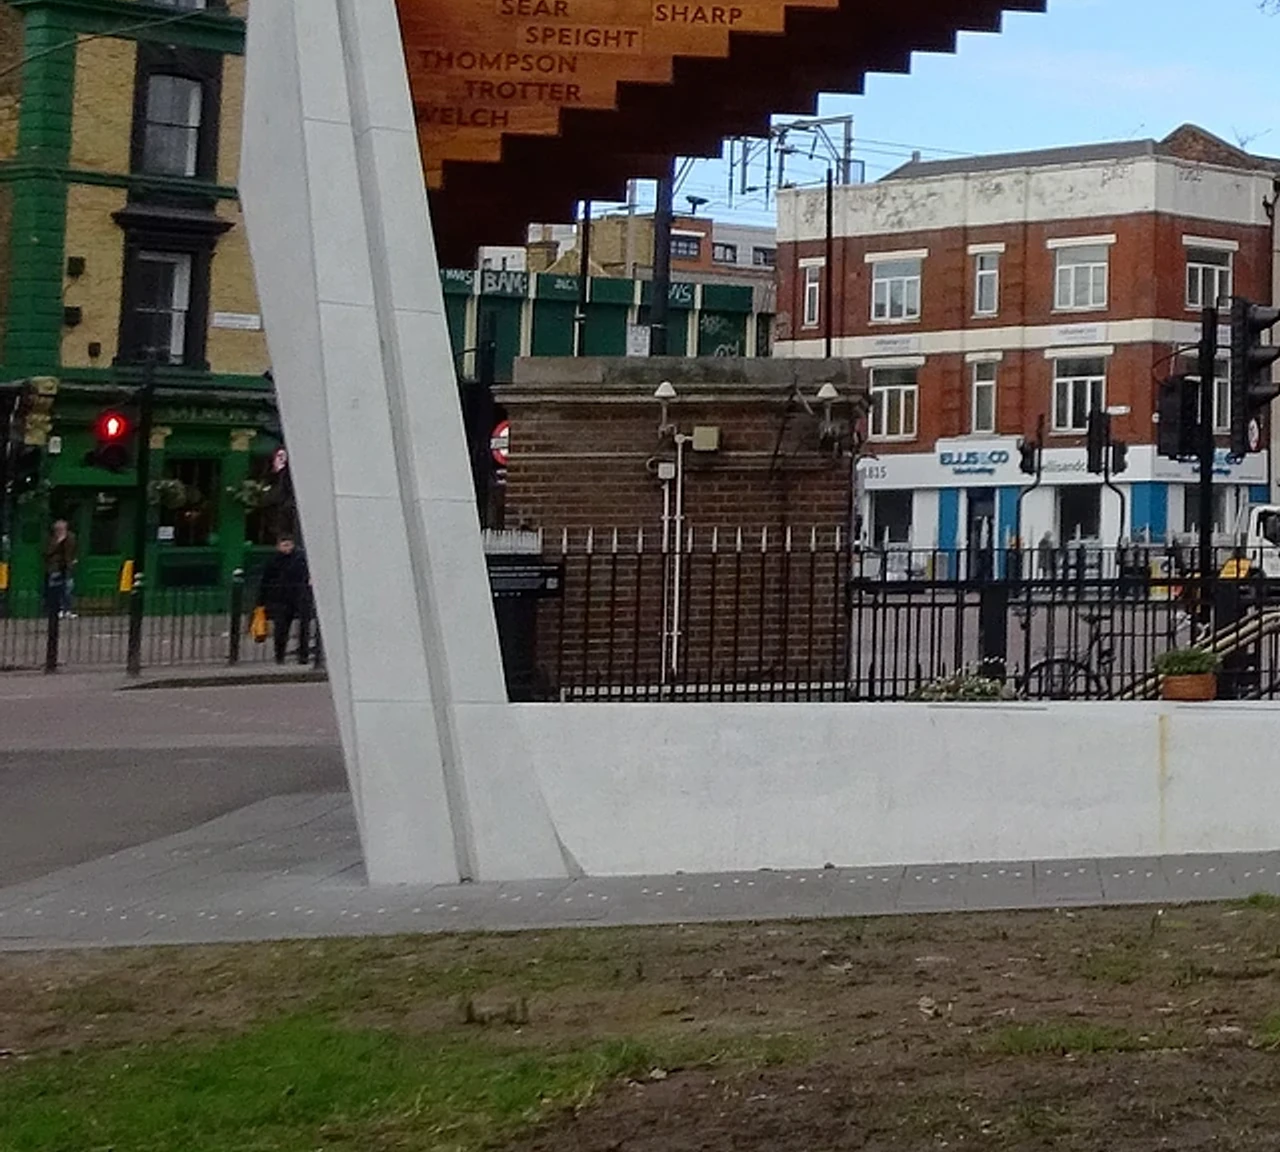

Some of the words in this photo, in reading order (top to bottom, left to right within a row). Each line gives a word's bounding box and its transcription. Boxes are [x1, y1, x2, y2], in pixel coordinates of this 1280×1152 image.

[655, 4, 742, 26] SHARP
[525, 26, 639, 48] SPEIGHT
[420, 50, 578, 74] THOMPSON
[464, 79, 582, 102] TROTTER
[417, 107, 509, 127] WELCH
